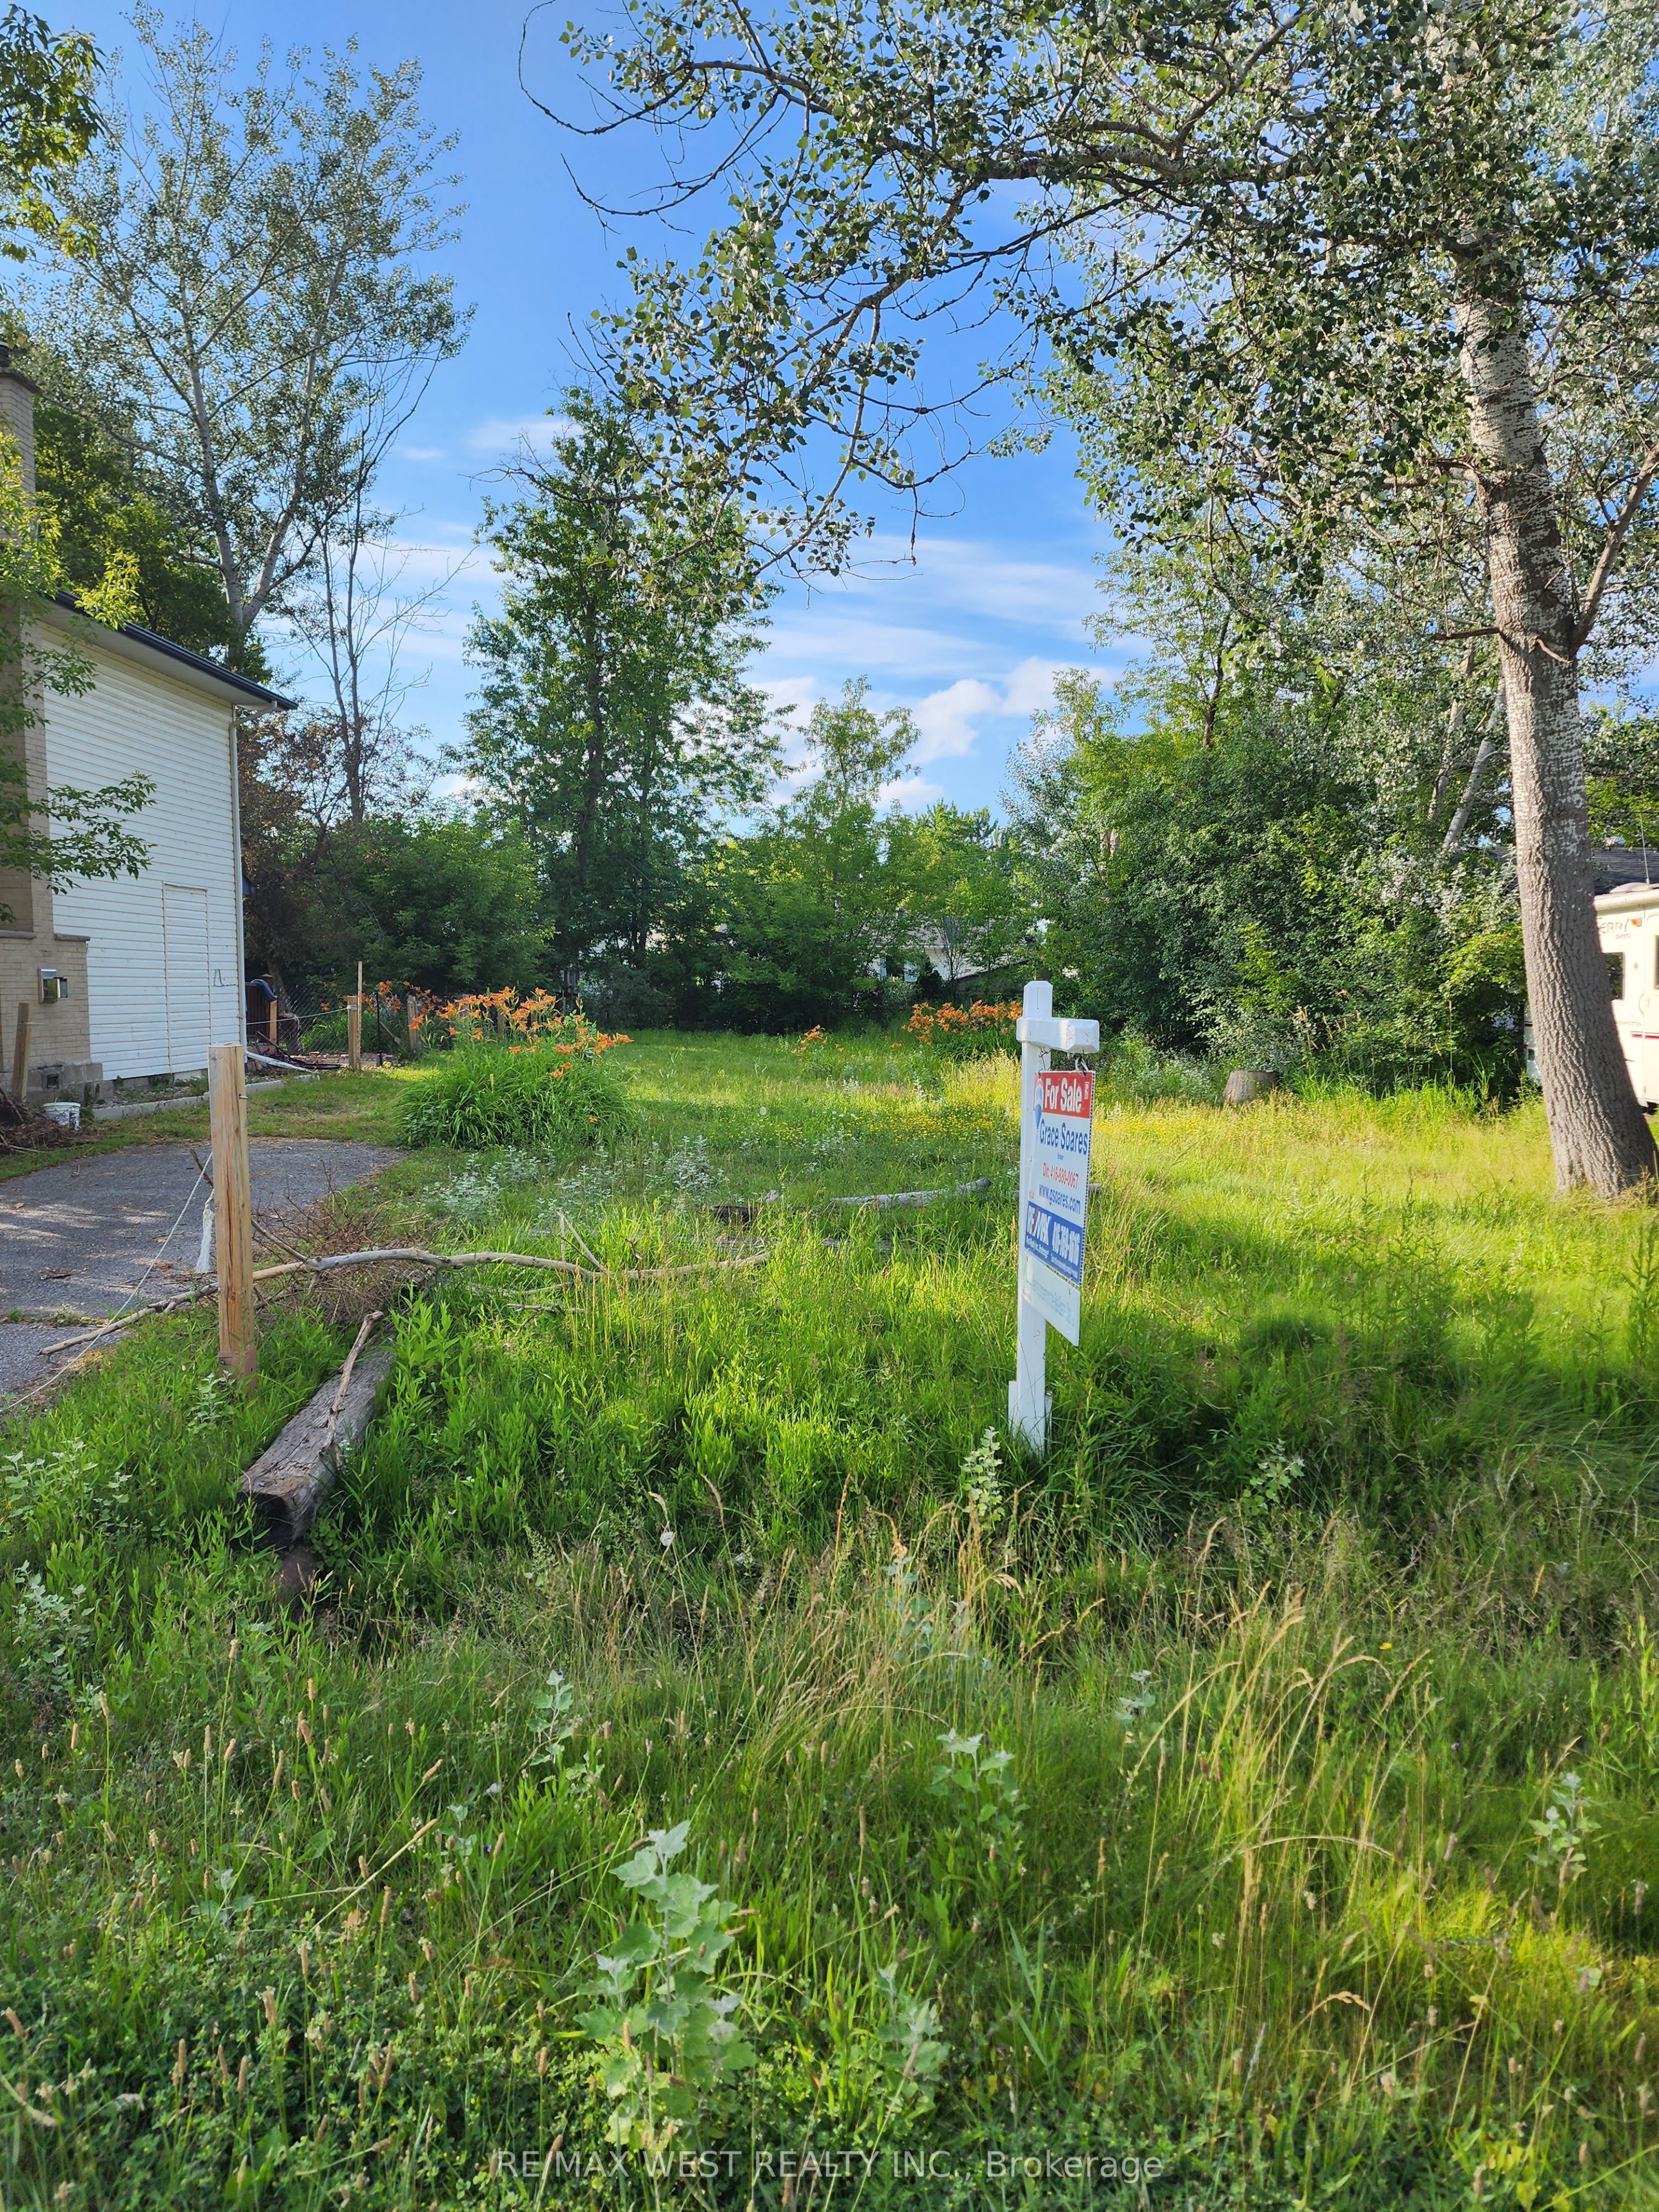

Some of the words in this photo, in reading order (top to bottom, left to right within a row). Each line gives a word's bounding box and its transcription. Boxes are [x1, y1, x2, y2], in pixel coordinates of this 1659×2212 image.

[1044, 1078, 1059, 1109] For
[1060, 1077, 1082, 1113] Sale
[1040, 1119, 1059, 1147] Grace
[1060, 1122, 1088, 1155] Soares
[1039, 1184, 1080, 1214] www.gsoares.com
[1027, 1205, 1051, 1245] RE/MAX
